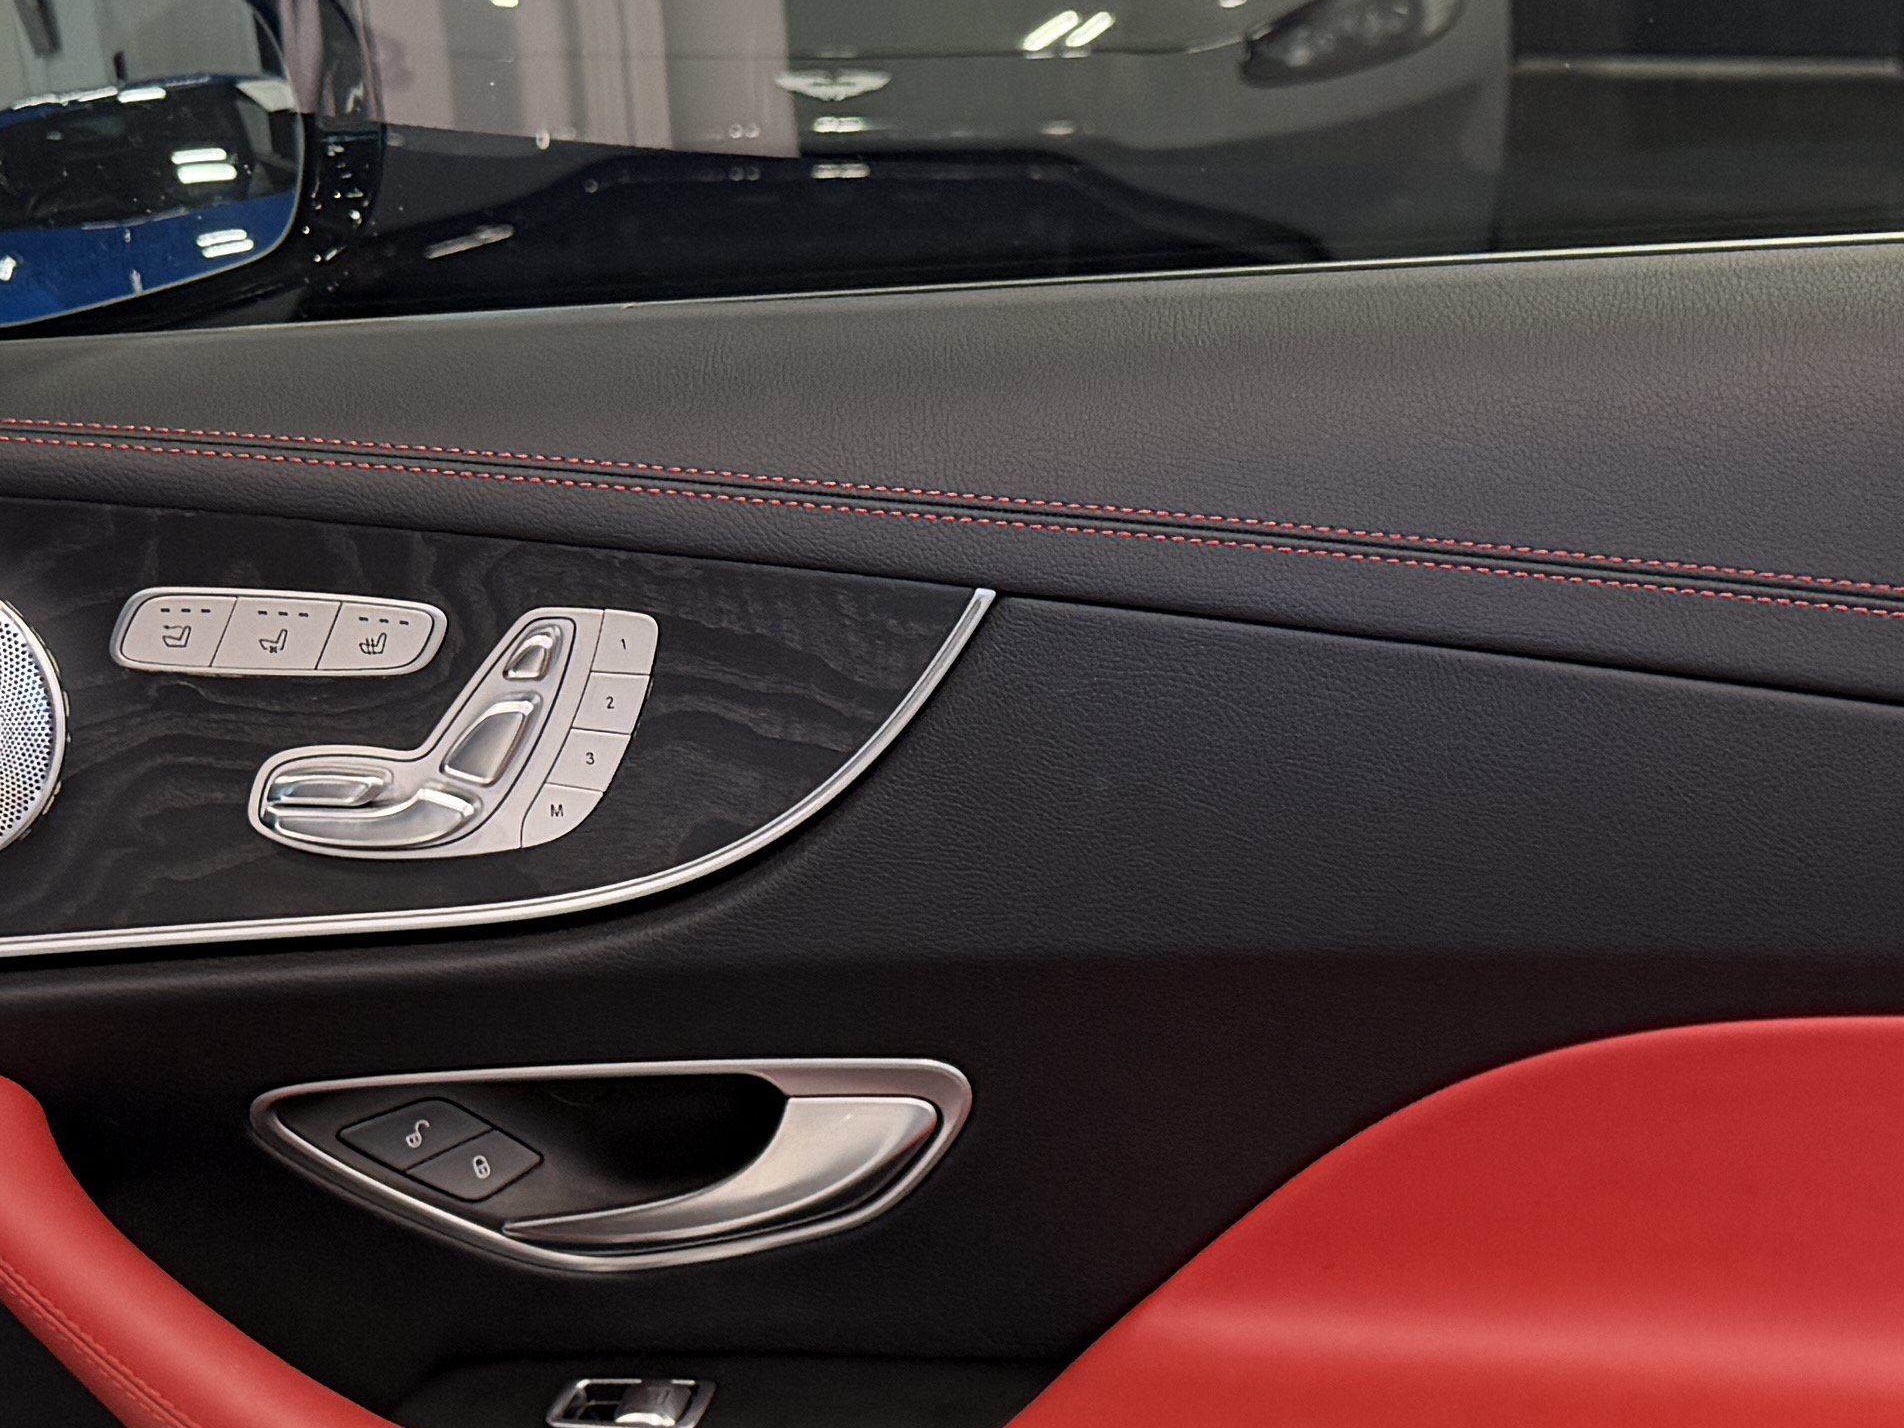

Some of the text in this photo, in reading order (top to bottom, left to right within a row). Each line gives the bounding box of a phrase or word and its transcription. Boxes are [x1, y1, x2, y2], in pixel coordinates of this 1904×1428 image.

[605, 696, 615, 709] 2
[585, 752, 596, 765] 3
[550, 804, 564, 817] M
